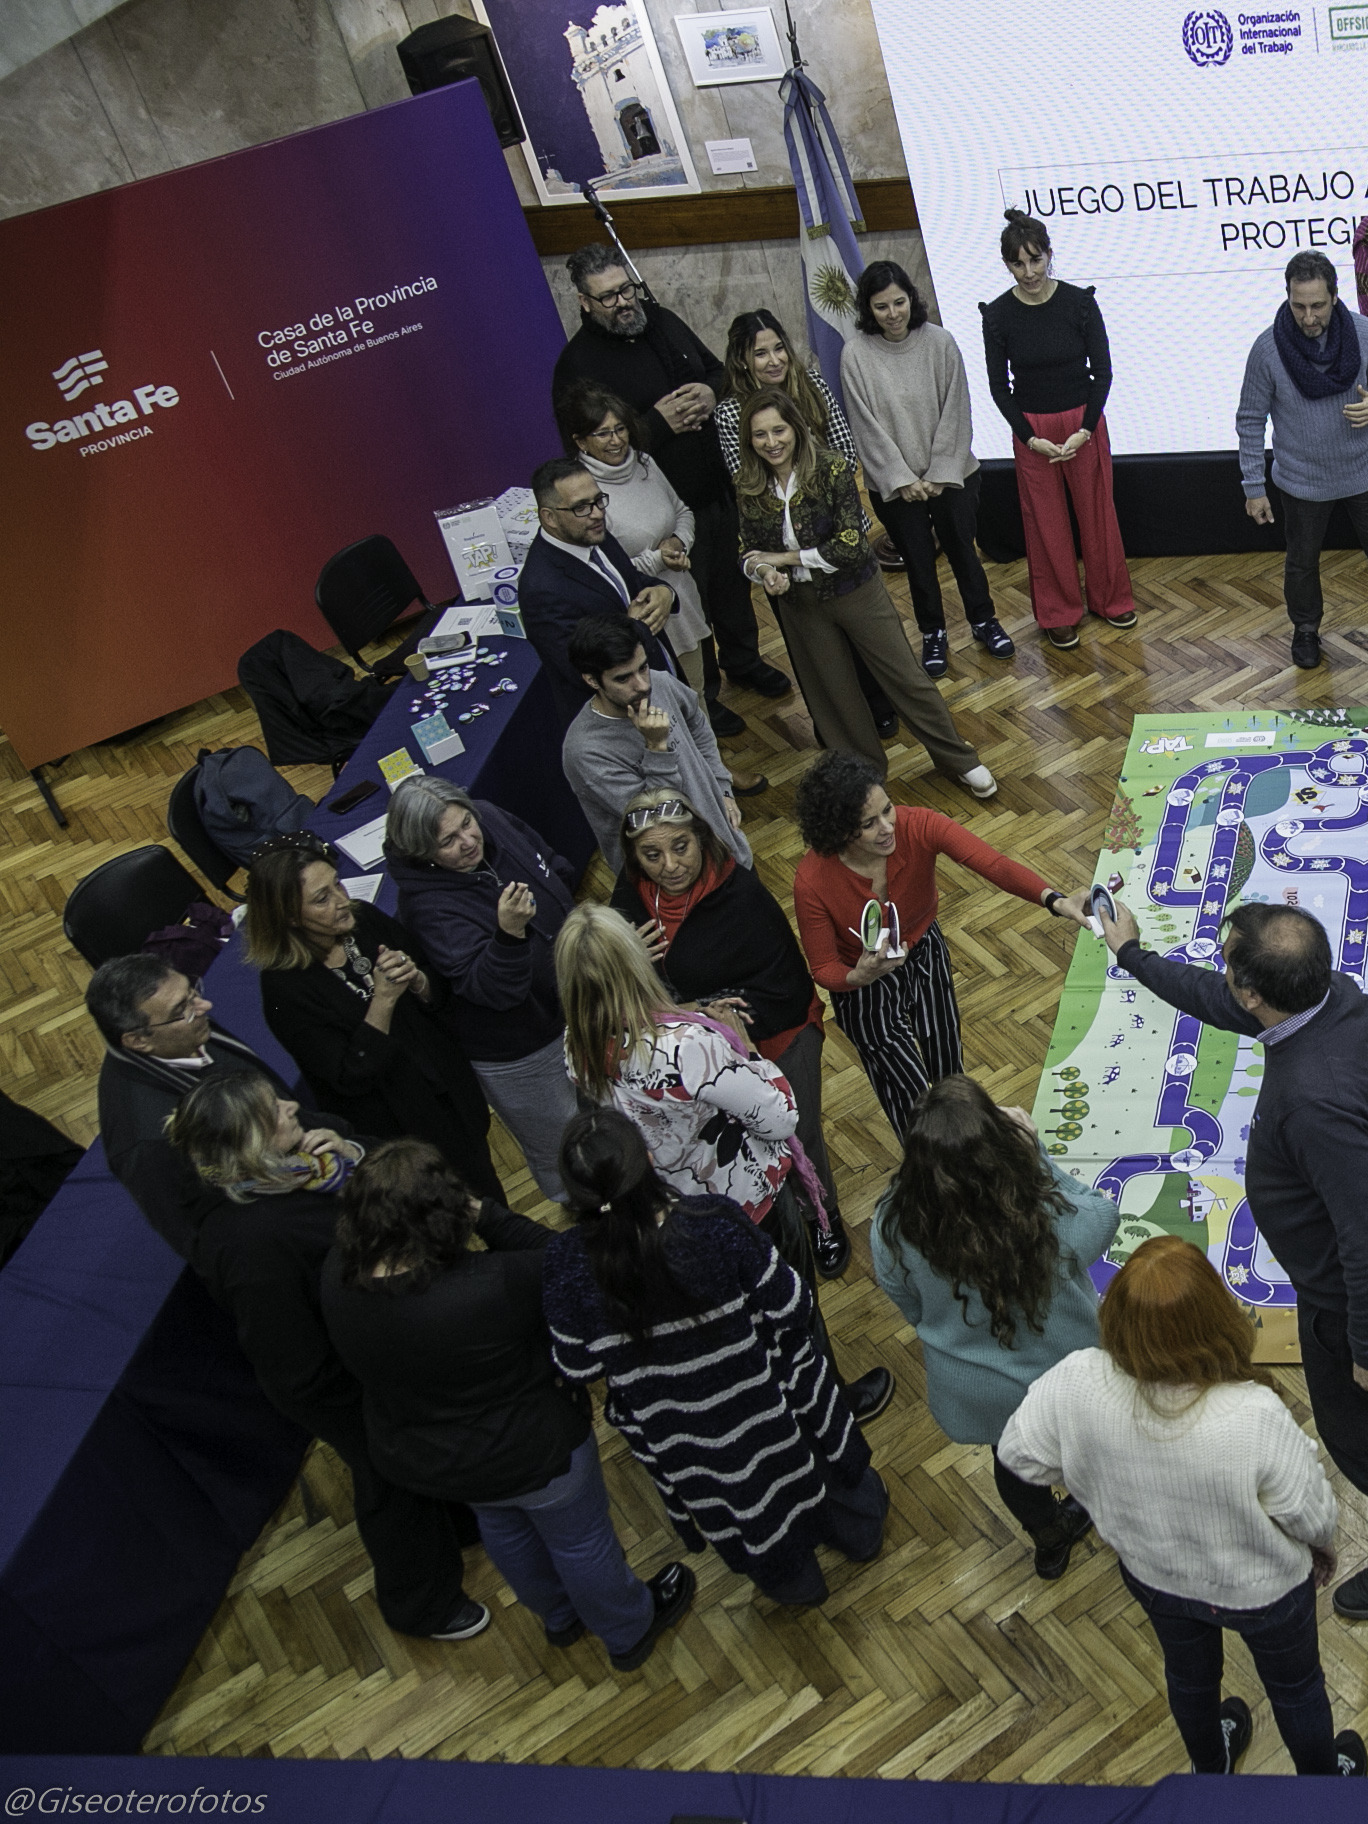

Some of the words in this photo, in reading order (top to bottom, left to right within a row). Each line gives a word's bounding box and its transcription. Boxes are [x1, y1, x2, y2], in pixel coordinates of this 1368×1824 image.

[1195, 22, 1219, 48] OIT
[1238, 10, 1300, 27] Organización
[1239, 25, 1301, 40] Internacional
[1241, 44, 1256, 54] del
[1258, 41, 1293, 54] Trabajo
[1025, 184, 1124, 217] JUEGO
[1133, 180, 1198, 211] DEL
[1203, 171, 1355, 206] TRABAJO
[1220, 215, 1360, 251] PROTEGI
[258, 322, 307, 348] Casa
[309, 313, 335, 331] de
[335, 306, 354, 322] la
[355, 276, 438, 315] Provincia
[267, 350, 292, 367] de
[294, 329, 348, 358] Santa
[349, 320, 375, 339] Fe
[273, 364, 306, 381] Ciudad
[307, 349, 352, 370] Autónoma
[353, 342, 366, 353] de
[366, 331, 400, 348] Buenos
[401, 321, 423, 336] Aires
[25, 399, 139, 450] Santa
[133, 384, 180, 415] Fe
[79, 425, 154, 458] PROVINCIA
[461, 543, 499, 568] TAP!
[1138, 735, 1194, 755] TAP!
